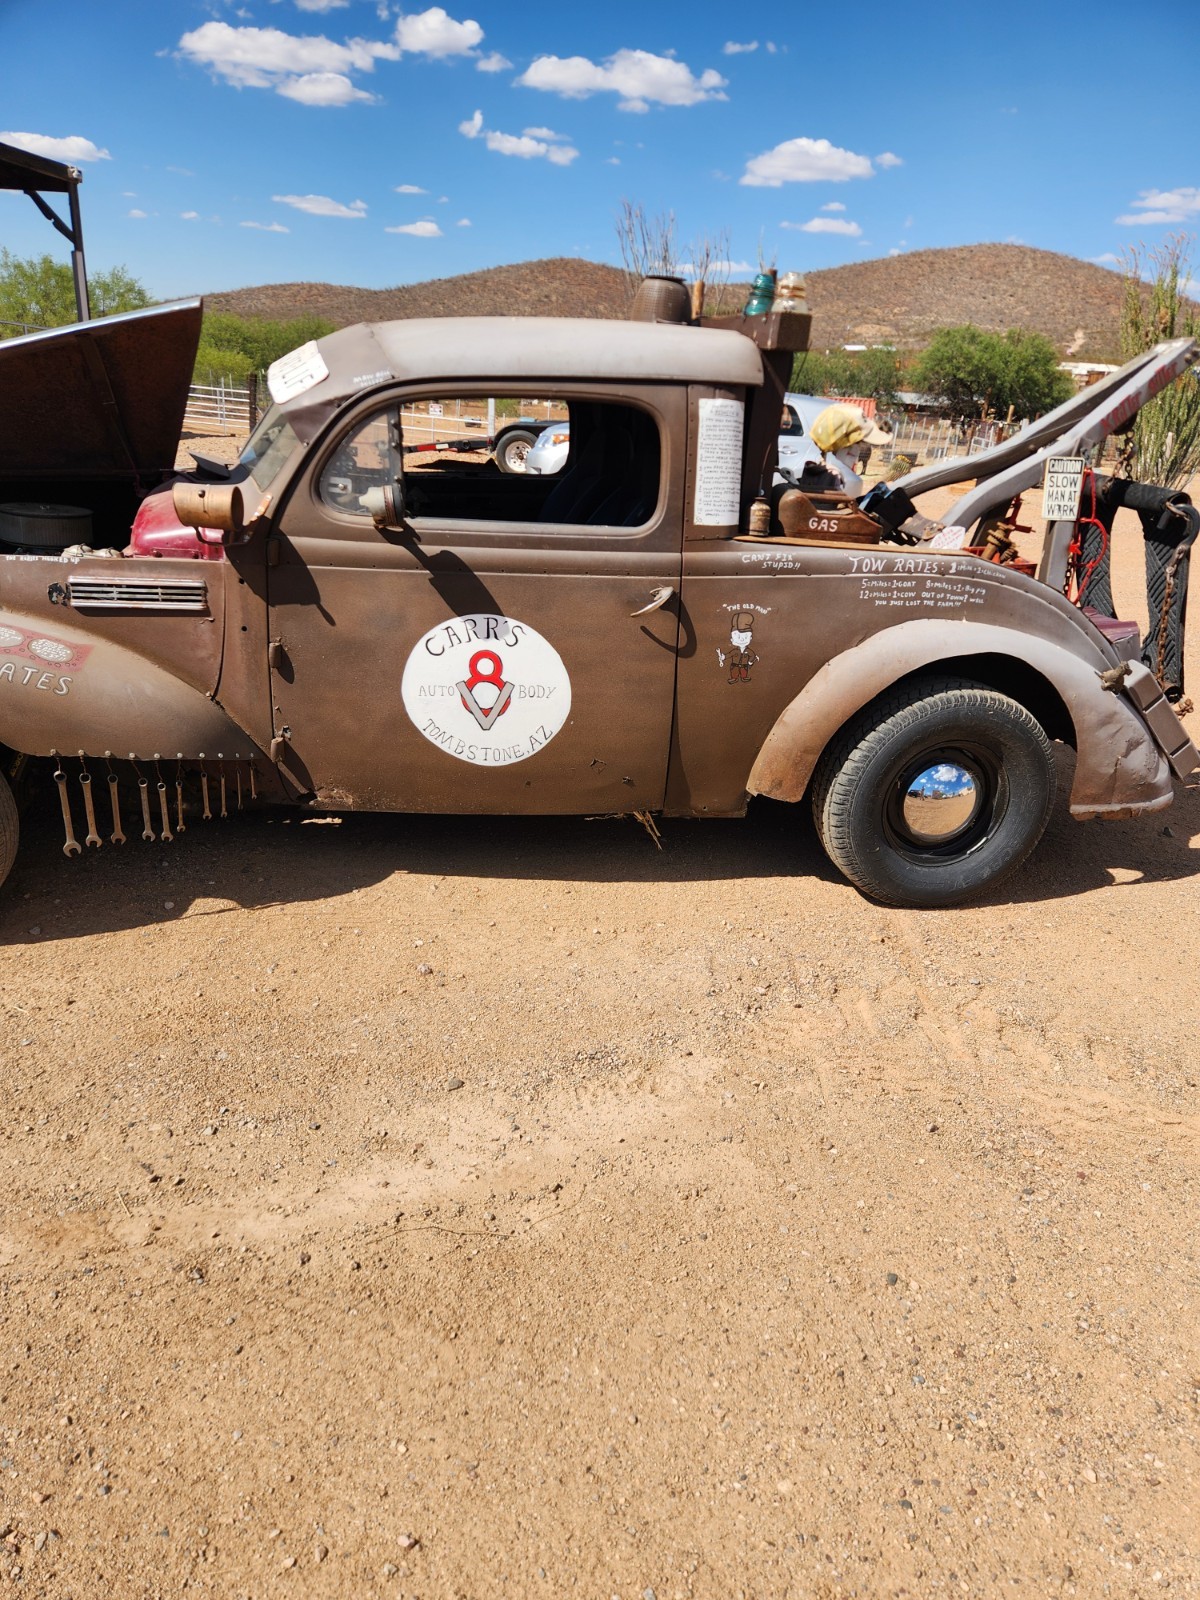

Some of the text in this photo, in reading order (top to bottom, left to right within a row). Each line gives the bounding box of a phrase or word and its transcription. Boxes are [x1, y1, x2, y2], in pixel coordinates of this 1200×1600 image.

[1049, 459, 1082, 474] CAUTION
[1049, 475, 1079, 488] SLOW
[1048, 489, 1078, 503] MAN AT
[808, 516, 839, 533] GAS
[761, 561, 801, 571] STUPID!!
[893, 557, 946, 574] RATES:
[921, 591, 935, 599] OUT
[425, 617, 527, 657] CARR'S
[418, 684, 557, 699] AUTO BODY
